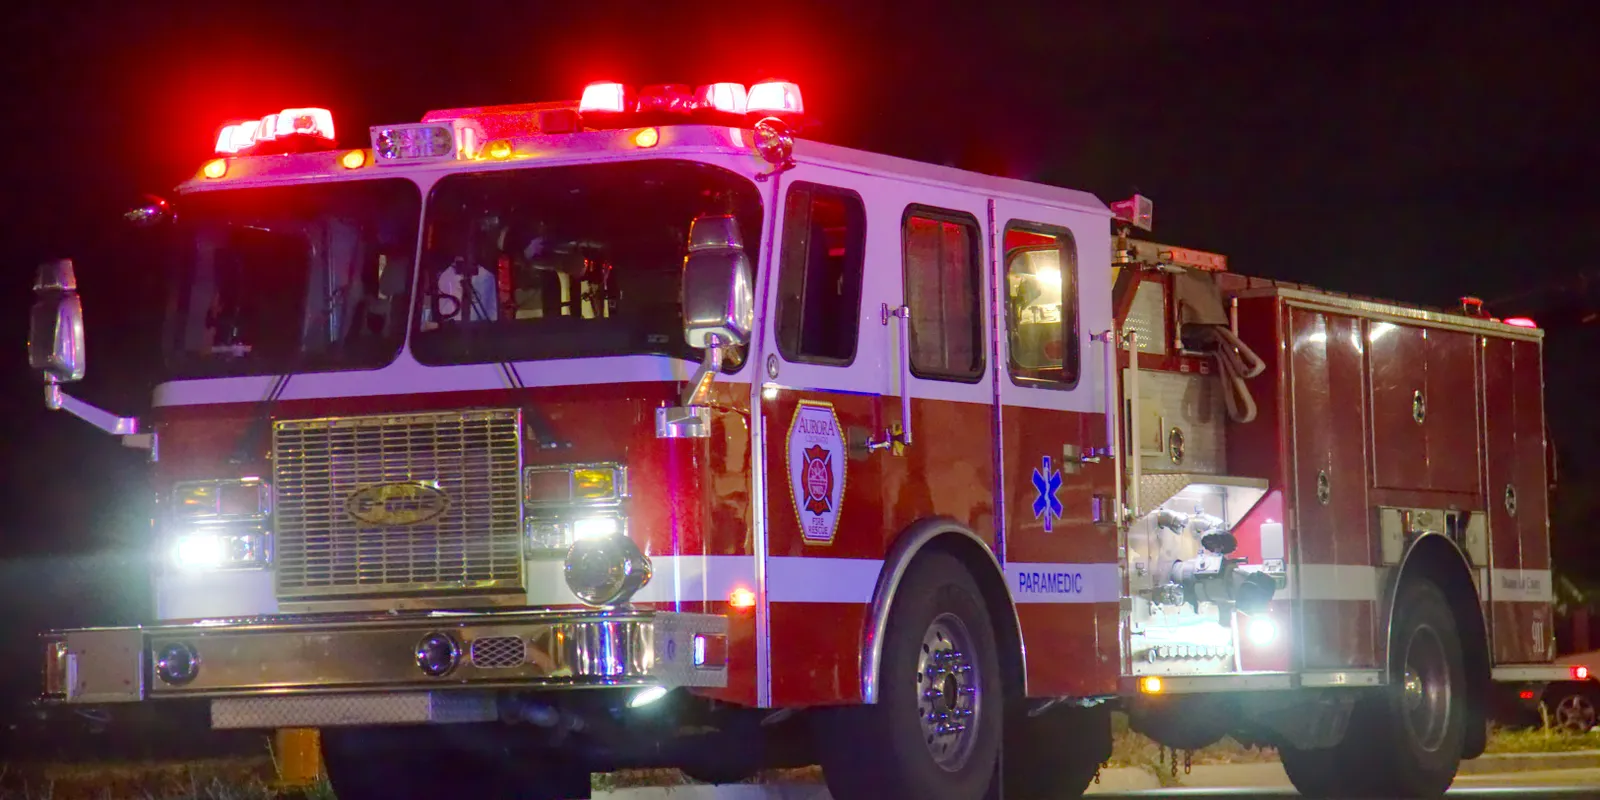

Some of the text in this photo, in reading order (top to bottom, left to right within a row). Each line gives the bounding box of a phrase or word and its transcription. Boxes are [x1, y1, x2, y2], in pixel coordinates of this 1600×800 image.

[798, 417, 835, 436] AURORA
[358, 494, 437, 512] E-ONE
[808, 525, 829, 535] RESCUE
[812, 517, 825, 526] FIRE
[1018, 572, 1083, 594] PARAMEDIC
[1531, 620, 1544, 652] 911
